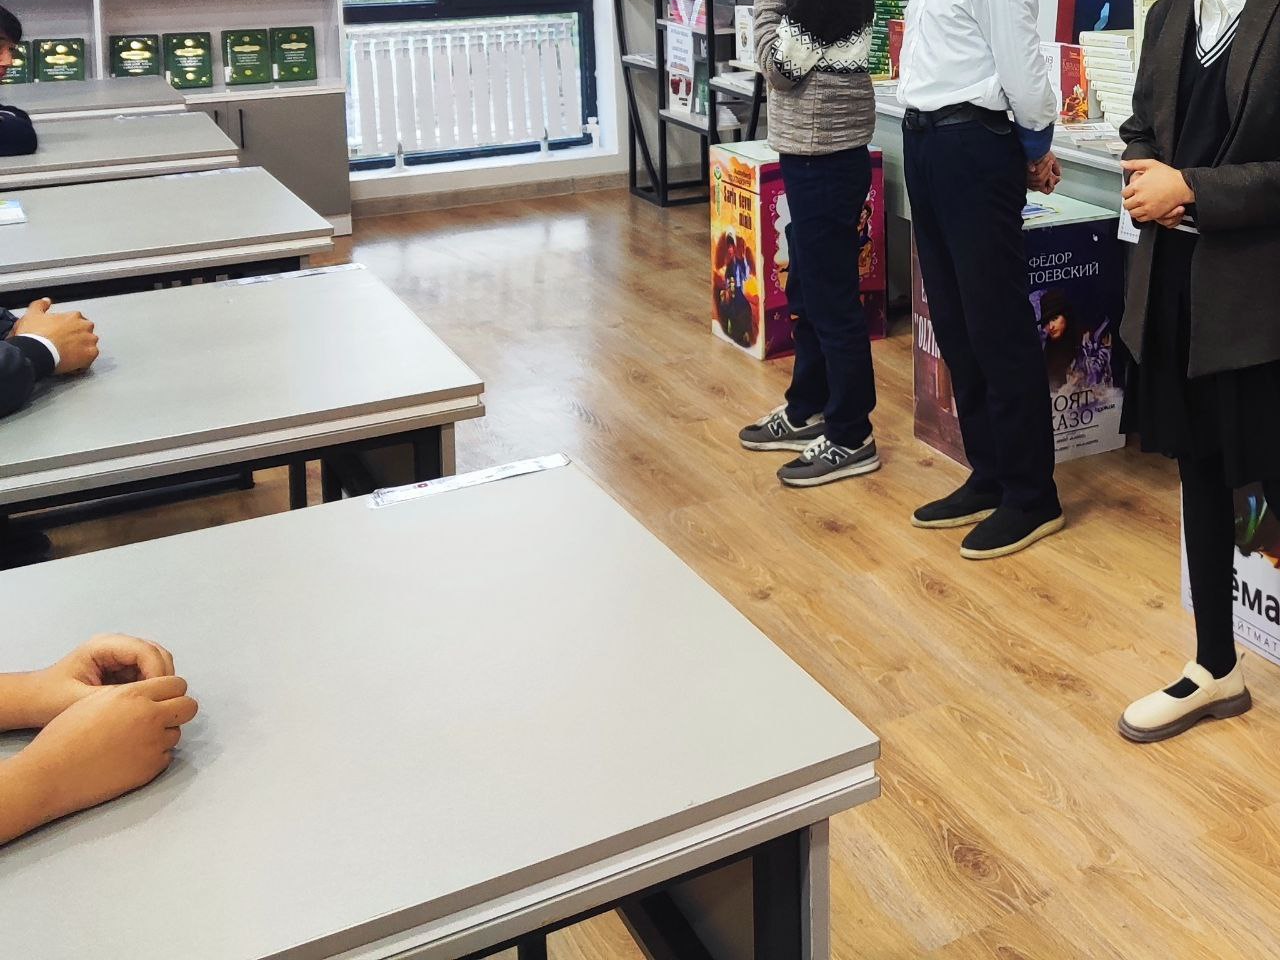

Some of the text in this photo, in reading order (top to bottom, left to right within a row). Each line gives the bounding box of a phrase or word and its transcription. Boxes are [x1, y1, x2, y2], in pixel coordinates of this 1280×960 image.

[1028, 252, 1072, 268] ФЁДОР
[1028, 261, 1099, 285] ТОЕВСКИЙ
[1053, 390, 1093, 412] ОЯТ
[1053, 408, 1094, 431] АЗО
